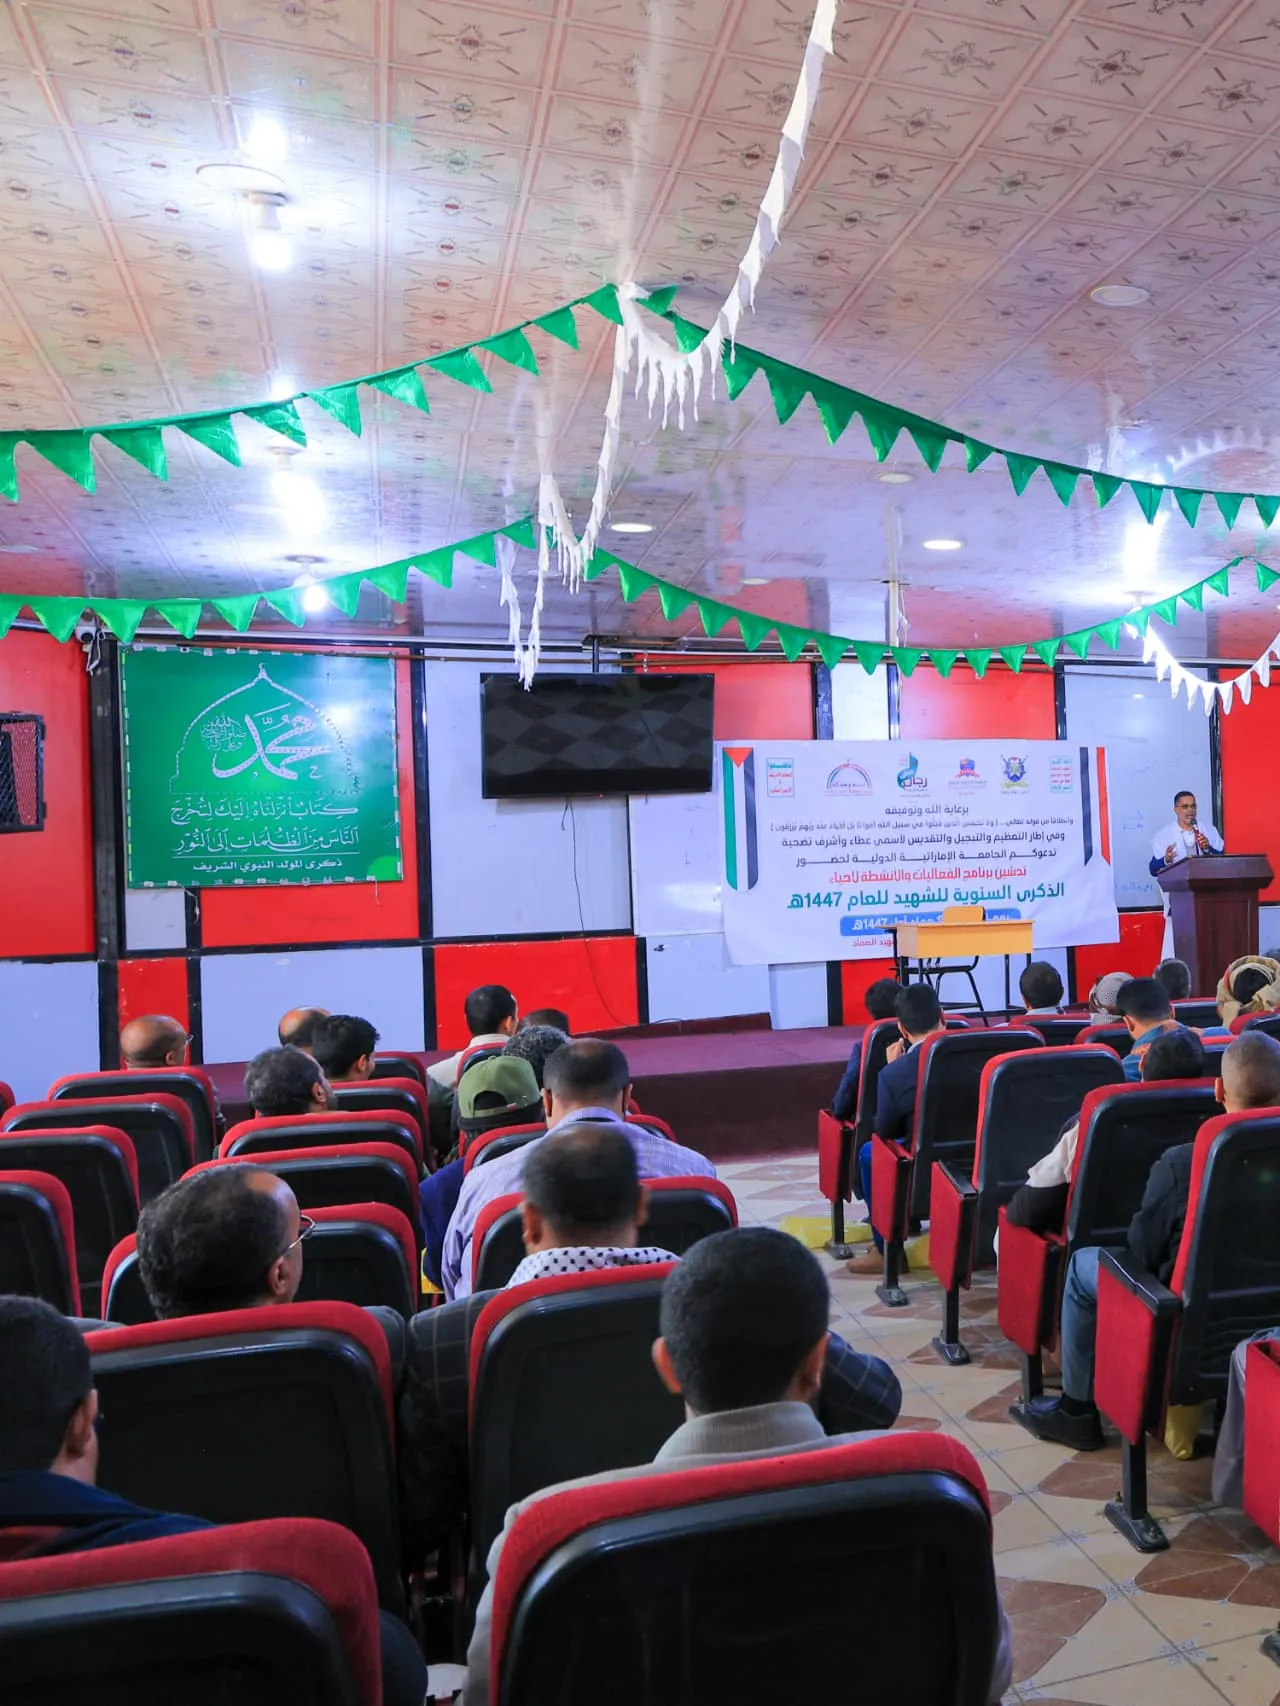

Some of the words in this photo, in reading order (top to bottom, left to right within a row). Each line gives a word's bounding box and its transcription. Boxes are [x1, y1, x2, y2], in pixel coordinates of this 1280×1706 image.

[884, 803, 922, 817] وتوفيقه
[924, 804, 941, 814] الله
[944, 804, 969, 816] برعاية
[781, 837, 812, 849] تضحية
[849, 835, 871, 847] عطاء
[907, 834, 952, 847] والتقديس
[955, 832, 992, 846] والتبجيل
[993, 832, 1028, 845] التعظيم
[1029, 831, 1045, 844] إطار
[1046, 832, 1065, 843] وفي
[795, 854, 850, 868] لحضور
[851, 853, 897, 865] الدولية
[959, 850, 1007, 862] الجامعة
[193, 860, 237, 873] الشريف
[240, 859, 274, 873] النبوي
[276, 860, 302, 871] المولد
[304, 857, 343, 870] ذكرى
[912, 867, 961, 884] الفعاليات
[962, 866, 993, 883] برنامج
[994, 865, 1027, 881] تدشين
[893, 886, 949, 909] للشهيد
[953, 884, 1011, 906] السنوية
[1016, 881, 1065, 903] الذكرى
[787, 891, 843, 909] 1447هـ
[847, 889, 889, 912] للعام
